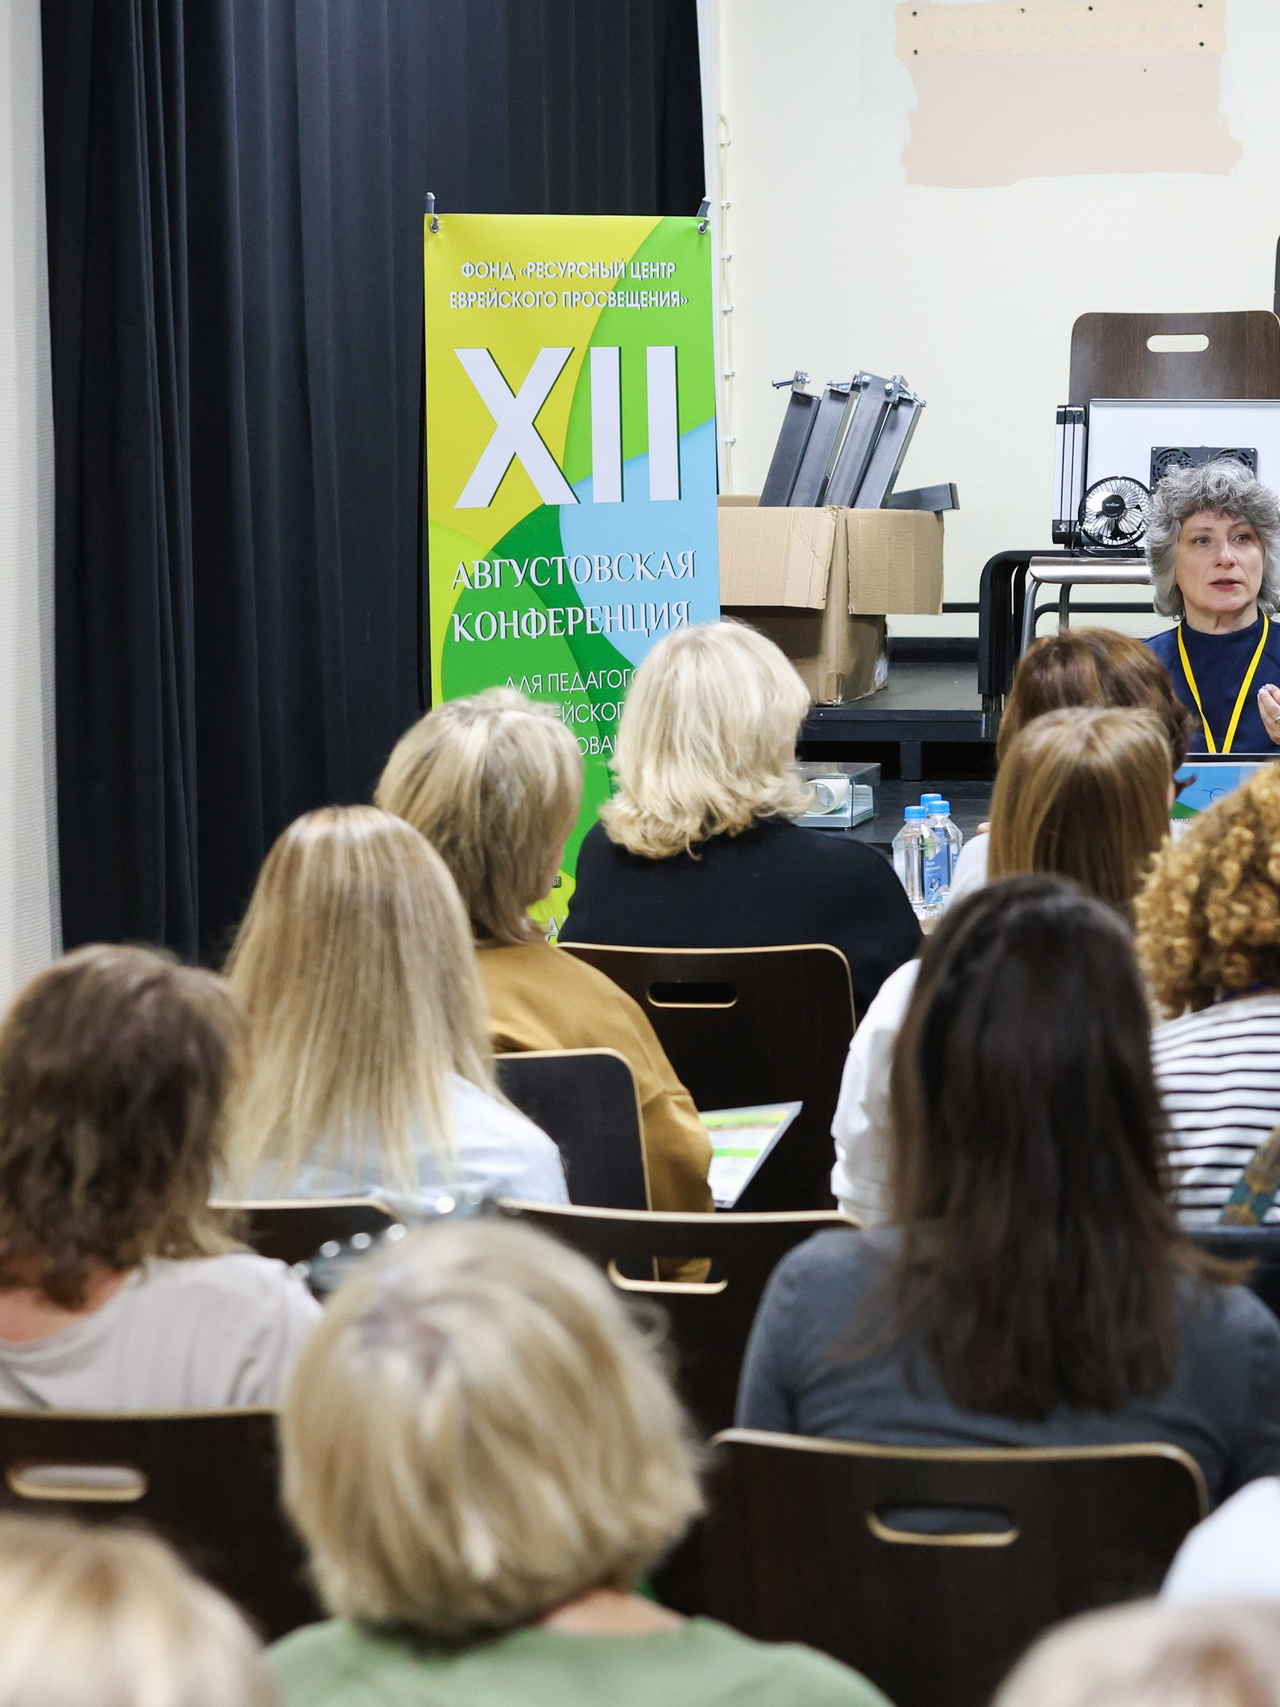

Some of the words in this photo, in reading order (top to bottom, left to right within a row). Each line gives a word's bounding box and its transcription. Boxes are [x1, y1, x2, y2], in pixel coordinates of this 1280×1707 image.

[461, 261, 516, 281] ФОНД
[519, 258, 626, 280] «РЕСУРСНЫЙ
[630, 261, 677, 281] ЦЕНТР
[450, 287, 558, 309] ЕВРЕЙСКОГО
[561, 290, 689, 310] ПРОСВЕЩЕНИЯ»
[453, 345, 682, 510] XII
[451, 550, 697, 591] АВГУСТОВСКАЯ
[451, 601, 693, 643] КОНФЕРЕНЦИЯ
[548, 669, 639, 694] ПЕДАГОГ
